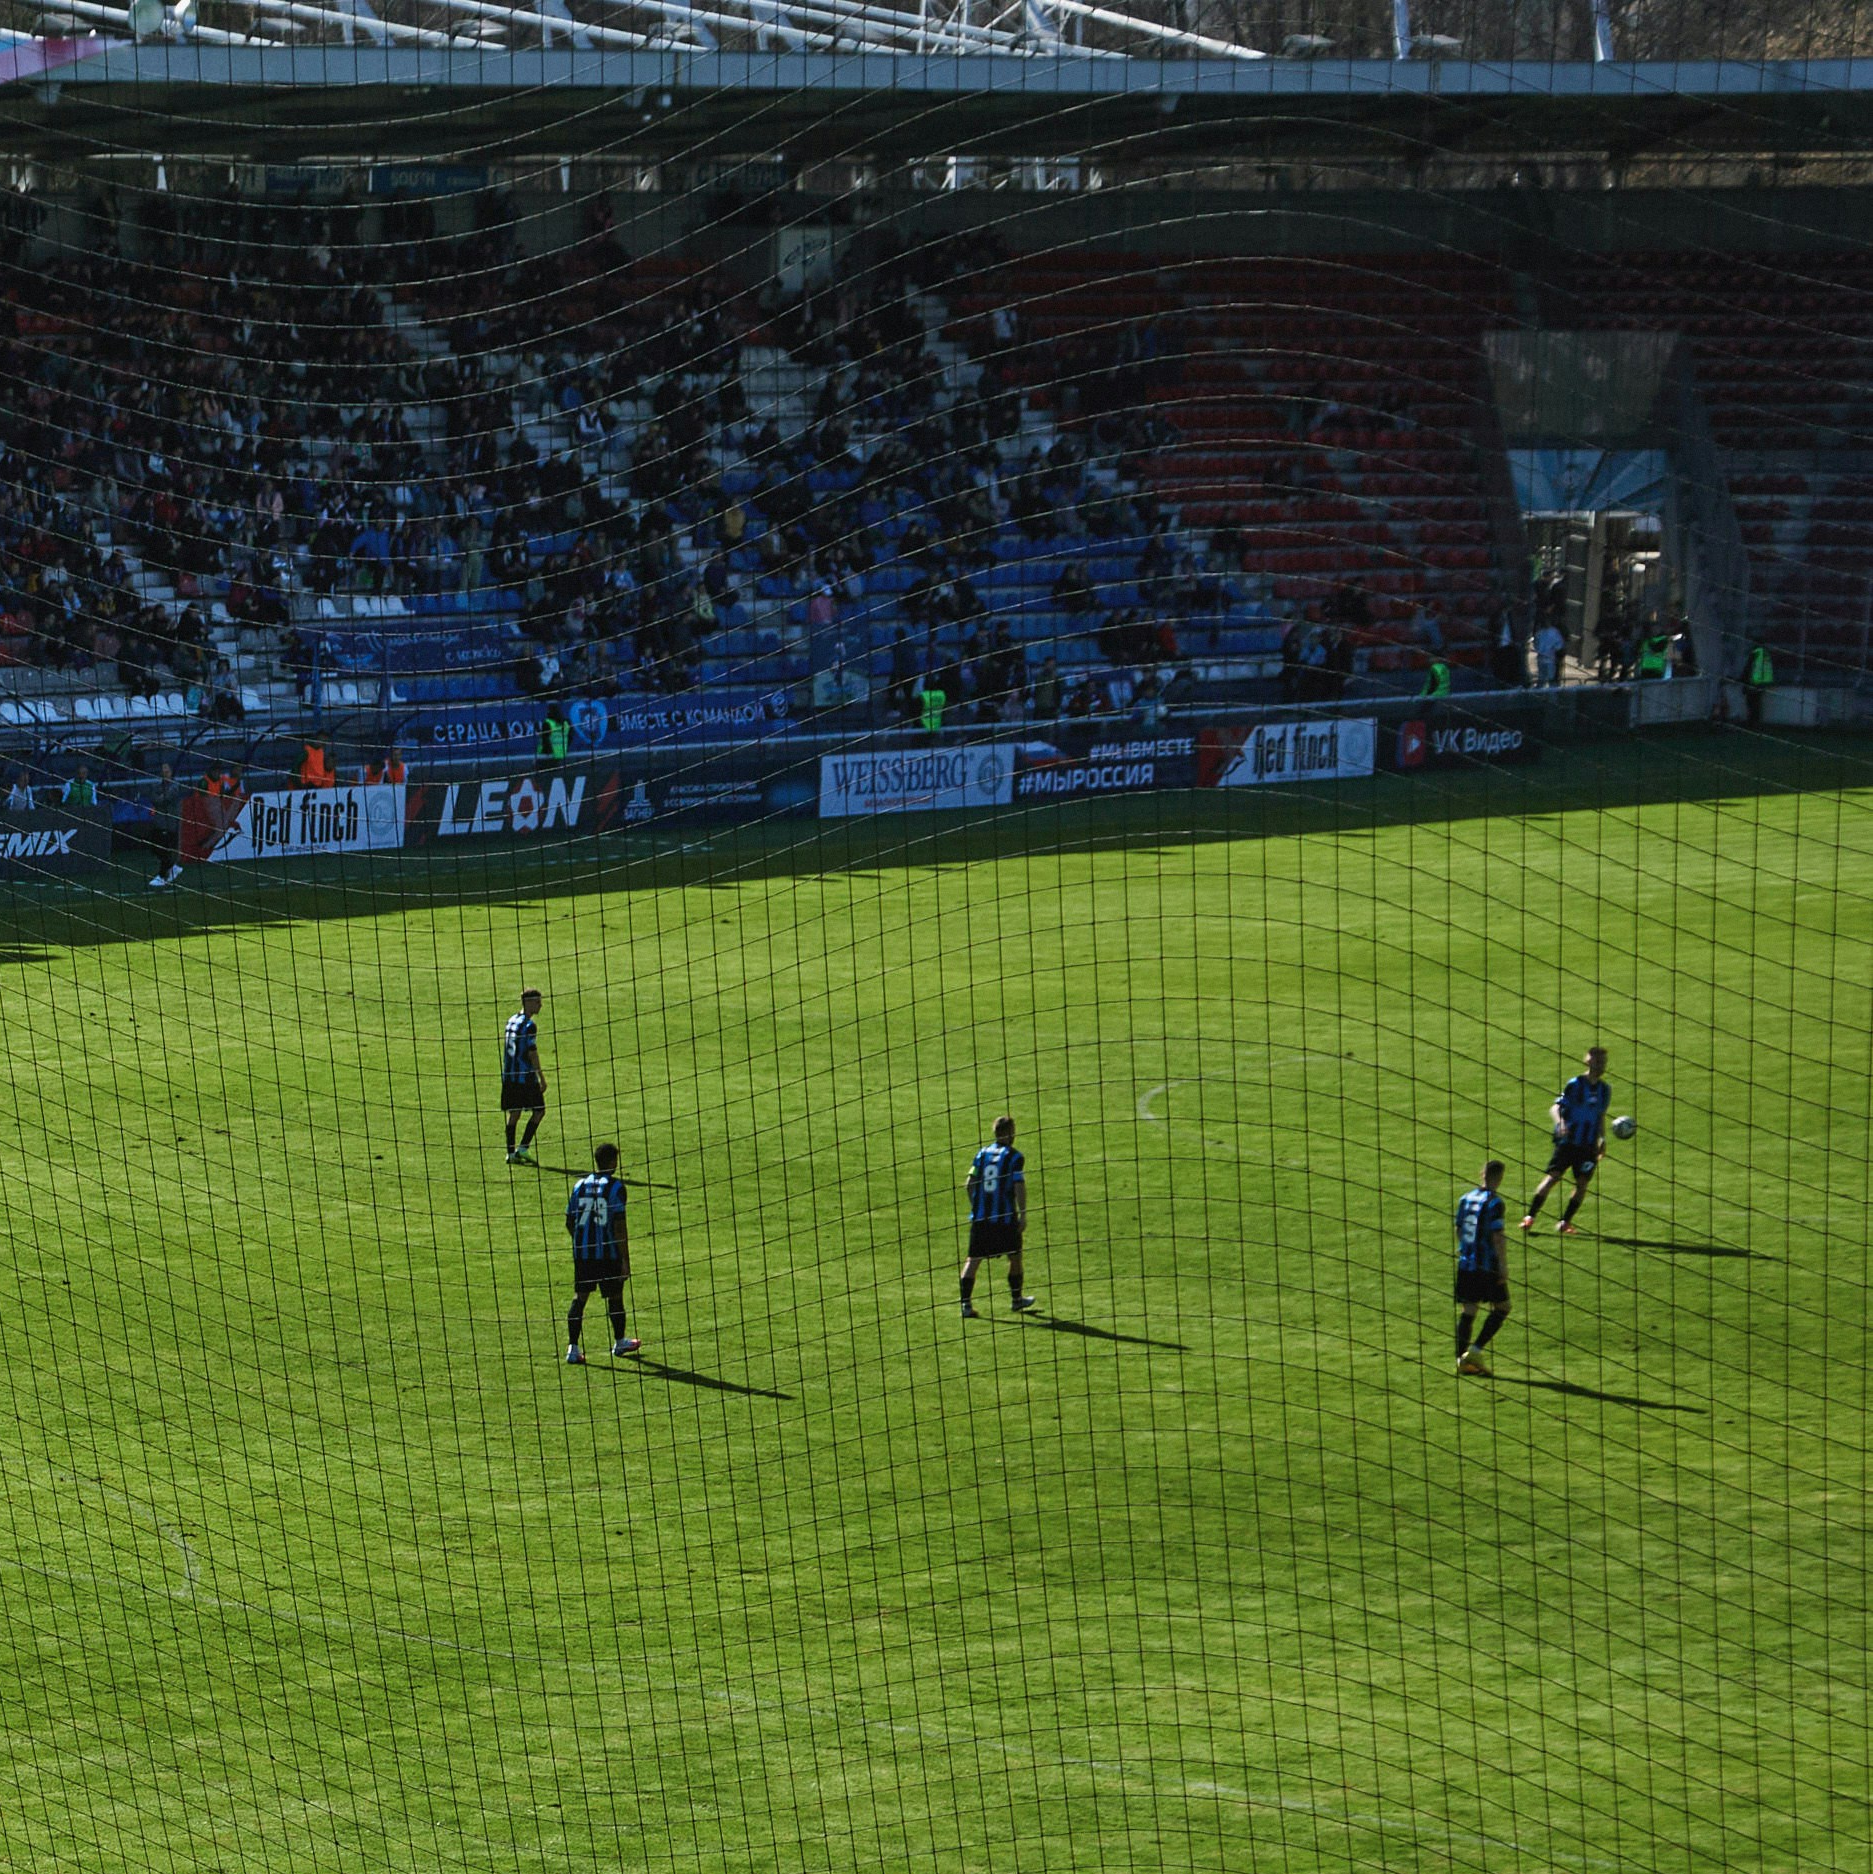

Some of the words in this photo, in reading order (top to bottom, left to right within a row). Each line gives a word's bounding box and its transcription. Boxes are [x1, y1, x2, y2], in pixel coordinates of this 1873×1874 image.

[432, 720, 501, 743] СЕРДЦА
[617, 709, 668, 733] ВМЕСТЕ
[671, 711, 683, 727] С
[684, 703, 766, 727] КОМАНДОЙ
[1089, 737, 1196, 762] #МЫВМЕСТЕ
[1464, 727, 1523, 754] Видео
[1018, 763, 1154, 795] #МЫРОССИЯ
[252, 793, 292, 856] Red
[300, 788, 358, 844] finch
[983, 1164, 1000, 1193] 8
[578, 1196, 608, 1226] 79
